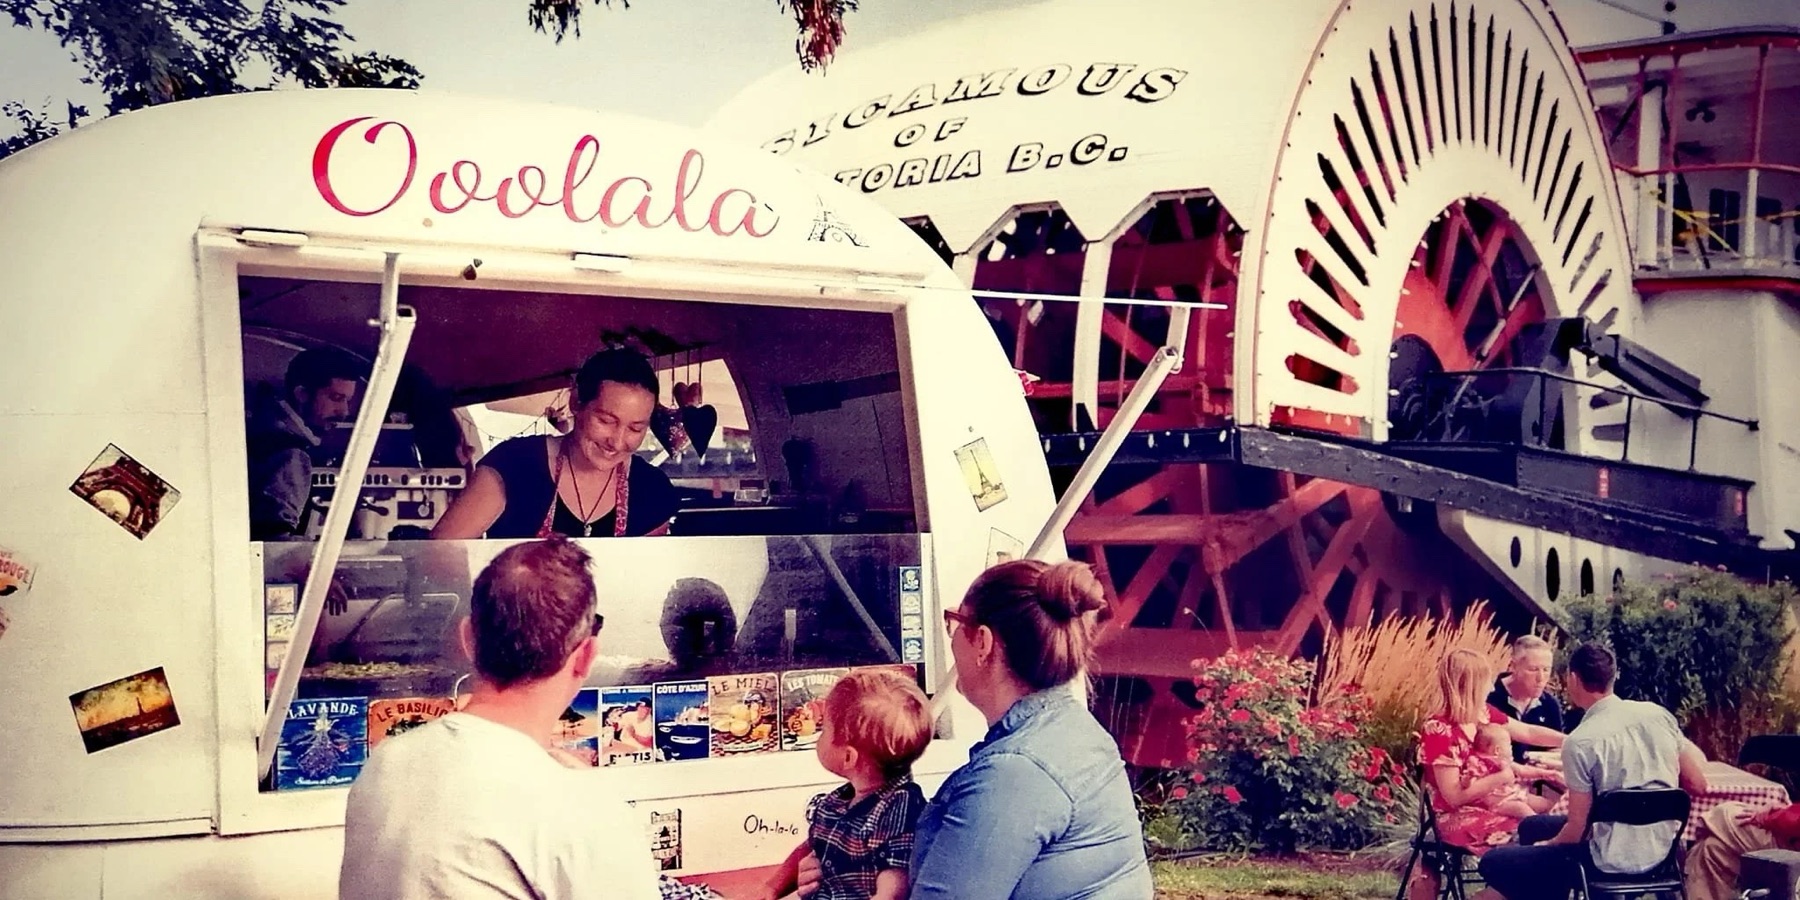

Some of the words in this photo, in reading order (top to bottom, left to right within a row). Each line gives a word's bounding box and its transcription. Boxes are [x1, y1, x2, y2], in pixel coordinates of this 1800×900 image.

[894, 116, 968, 148] OF
[833, 148, 982, 194] TORIA
[1006, 133, 1129, 174] B.C.
[311, 115, 780, 238] Ooolala
[656, 684, 678, 694] CÔTE
[678, 683, 707, 693] D'AZUR
[711, 680, 729, 696] LE
[736, 677, 776, 691] MIEL
[288, 701, 360, 719] LAVANDE
[376, 706, 393, 723] LE
[743, 813, 799, 836] Oh-la-la
